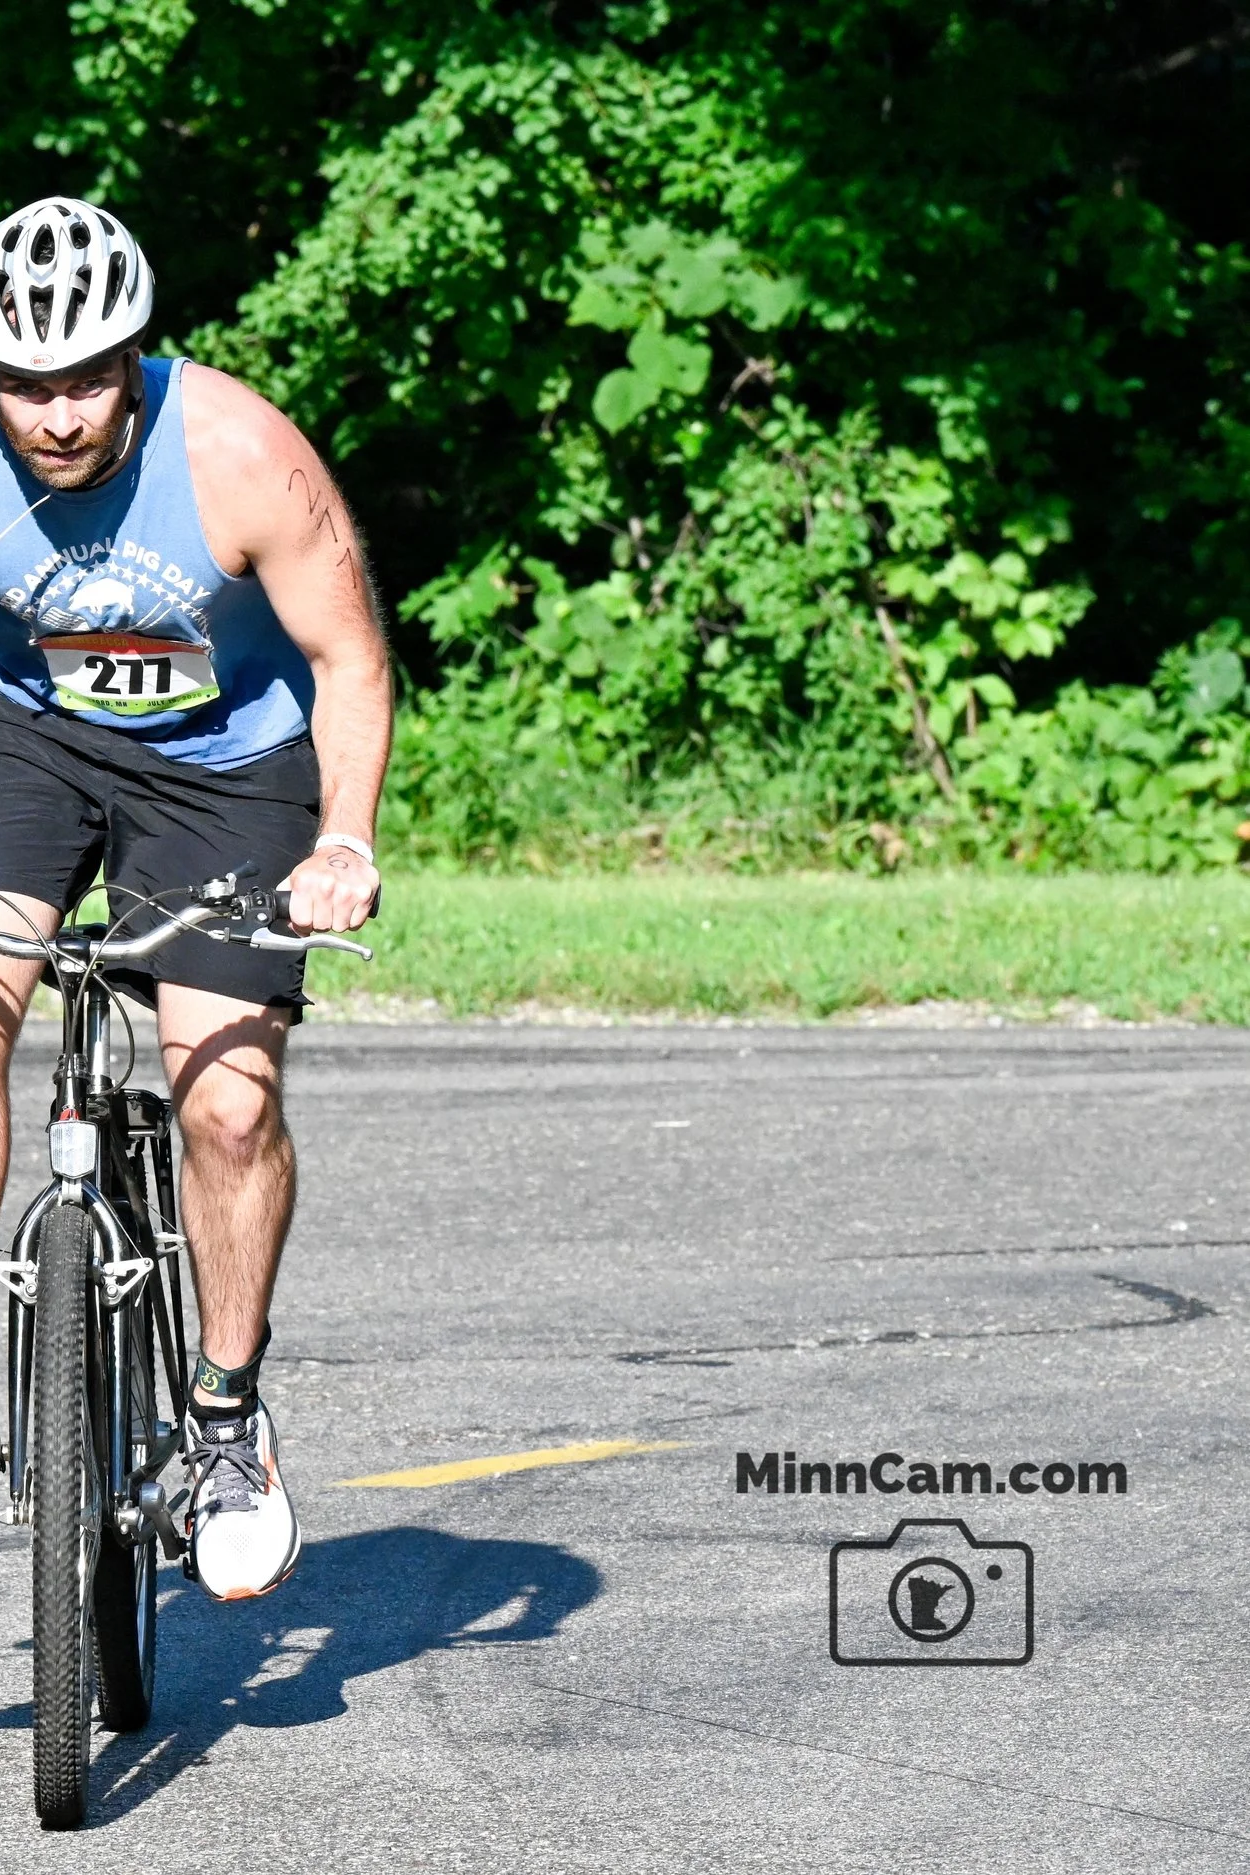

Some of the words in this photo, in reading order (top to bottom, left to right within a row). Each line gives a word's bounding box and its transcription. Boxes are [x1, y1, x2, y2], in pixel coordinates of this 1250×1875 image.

[23, 537, 117, 591] ANNUAL
[121, 540, 163, 571] PIG
[161, 563, 212, 602] DAY
[84, 655, 172, 695] 277
